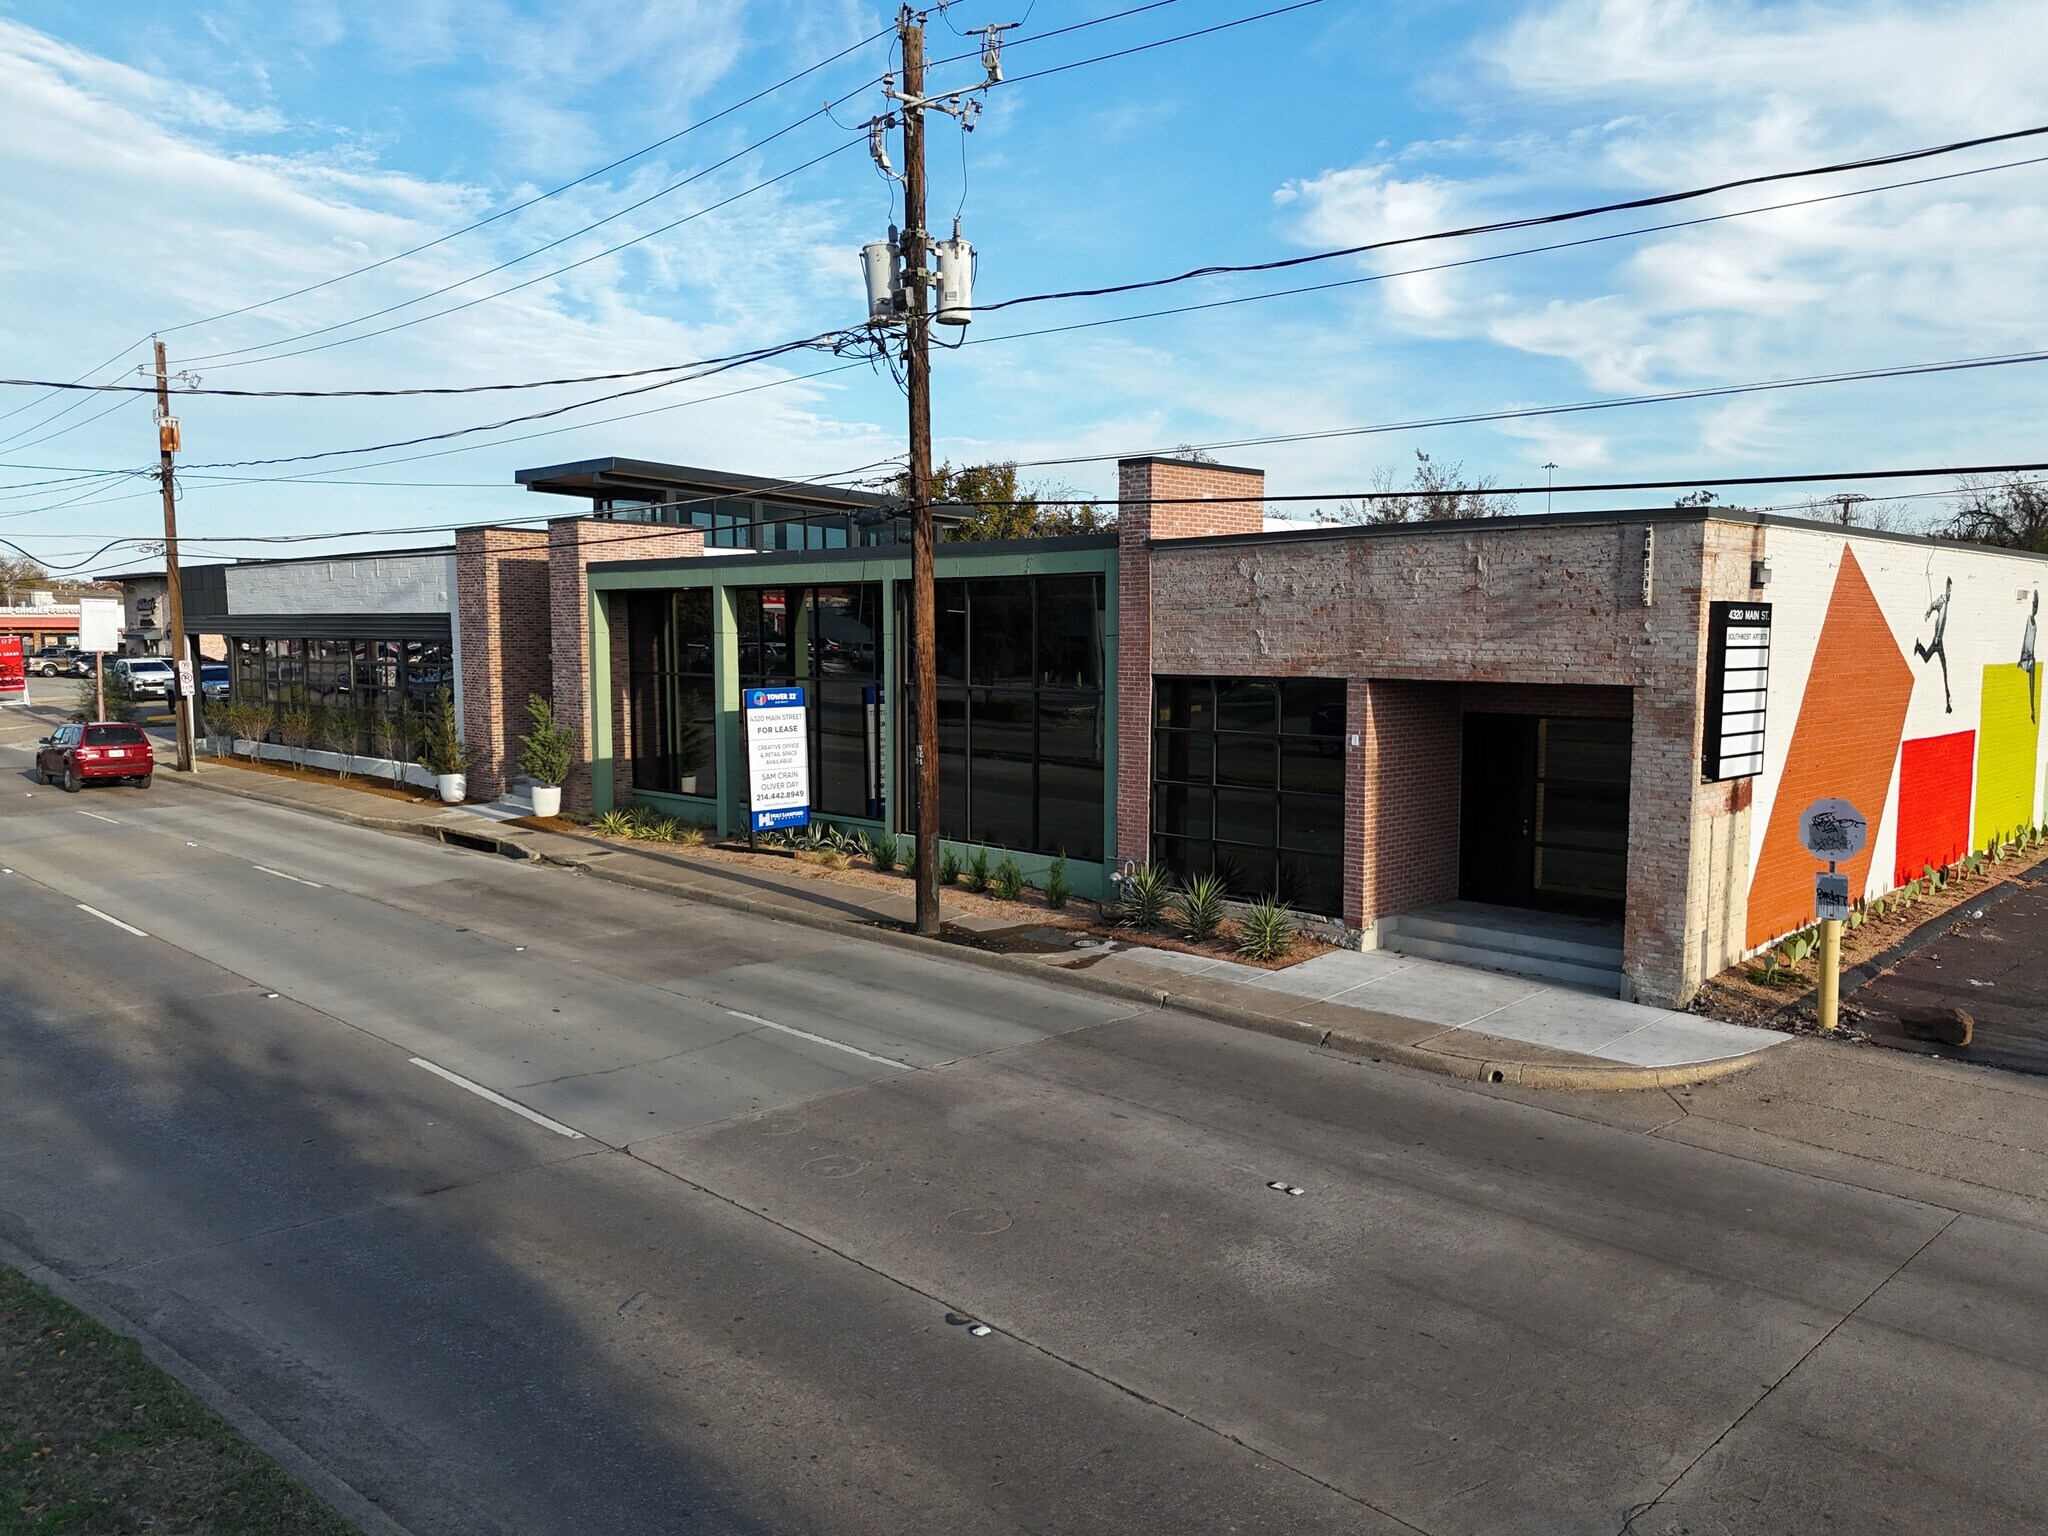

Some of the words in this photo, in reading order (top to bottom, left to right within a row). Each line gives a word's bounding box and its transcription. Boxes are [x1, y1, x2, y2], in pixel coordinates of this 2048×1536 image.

[15, 606, 48, 614] CHICKEN
[1728, 609, 1744, 620] 4320
[1744, 609, 1760, 620] MAIN
[1760, 610, 1770, 620] ST.
[766, 692, 788, 700] TOWER
[778, 771, 798, 779] CRAIN
[761, 782, 785, 790] OLIVER
[757, 790, 804, 801] 214.442.8949
